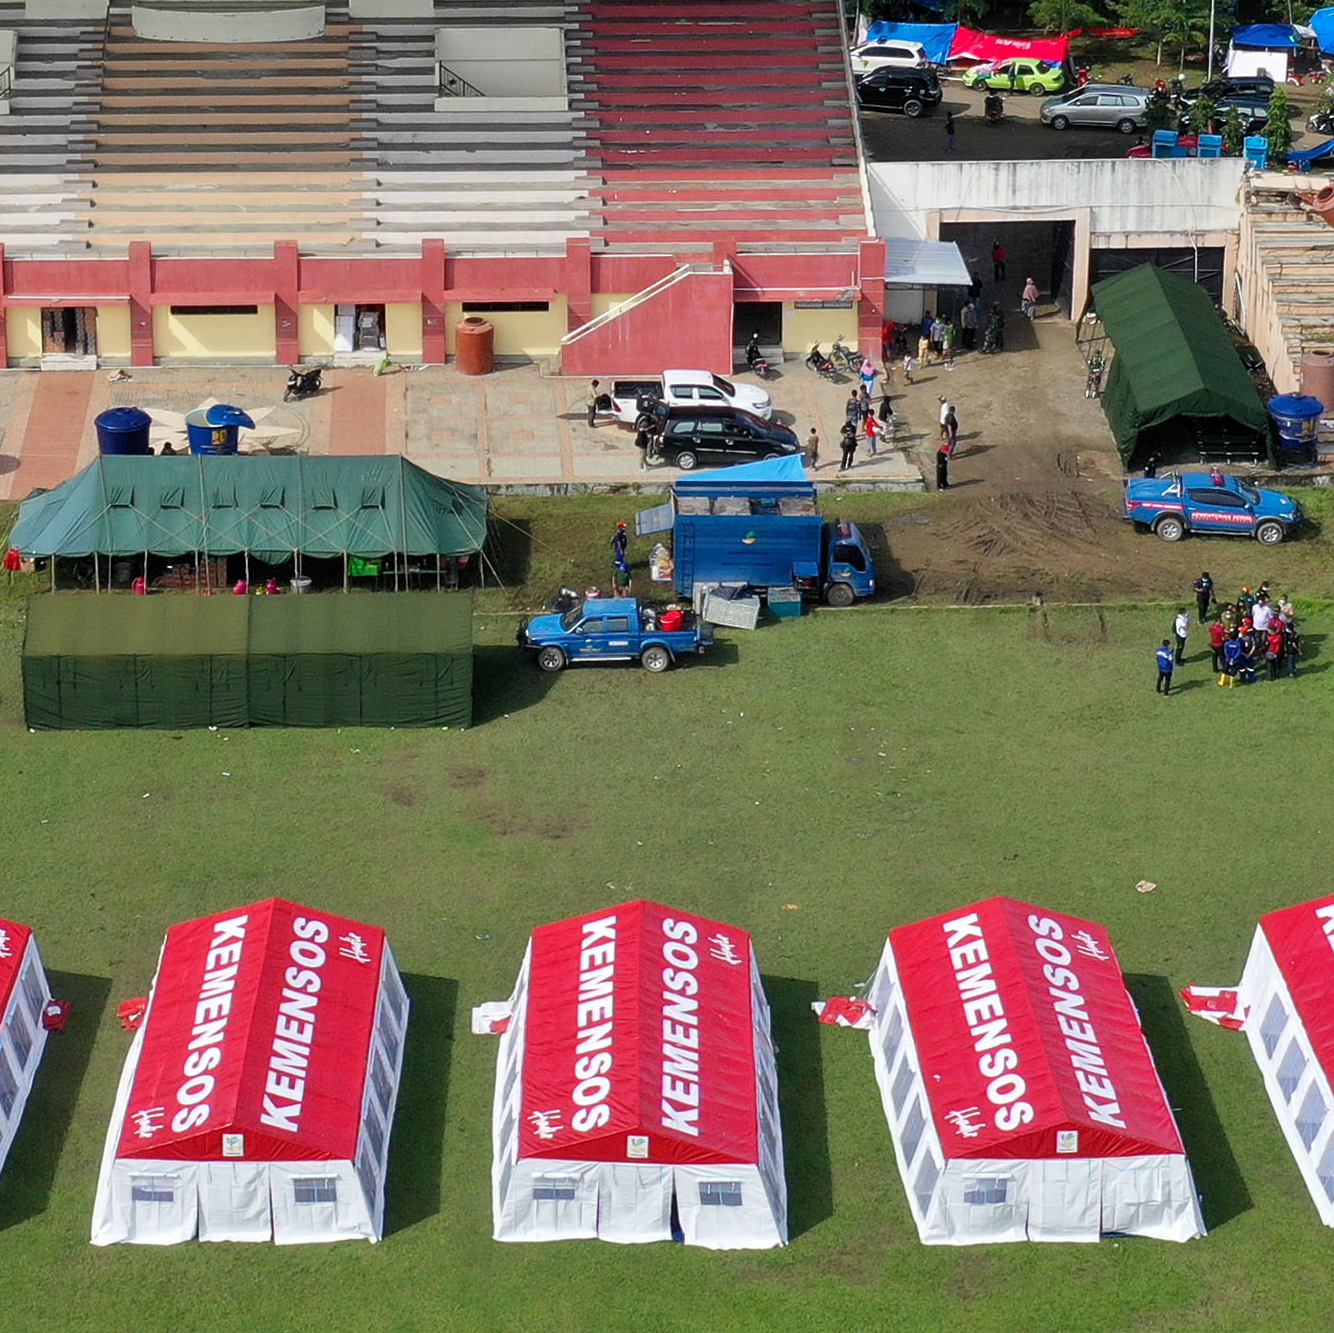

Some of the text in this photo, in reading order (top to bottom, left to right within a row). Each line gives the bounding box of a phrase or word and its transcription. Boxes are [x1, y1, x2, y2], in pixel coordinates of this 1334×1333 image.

[171, 914, 249, 1133] KEMENSOS
[260, 917, 329, 1132] KEMENSOS
[571, 915, 617, 1132] KEMENSOS
[661, 918, 700, 1137] KEMENSOS
[943, 912, 1034, 1131] KEMENSOS
[1028, 914, 1127, 1129] KEMENSOS
